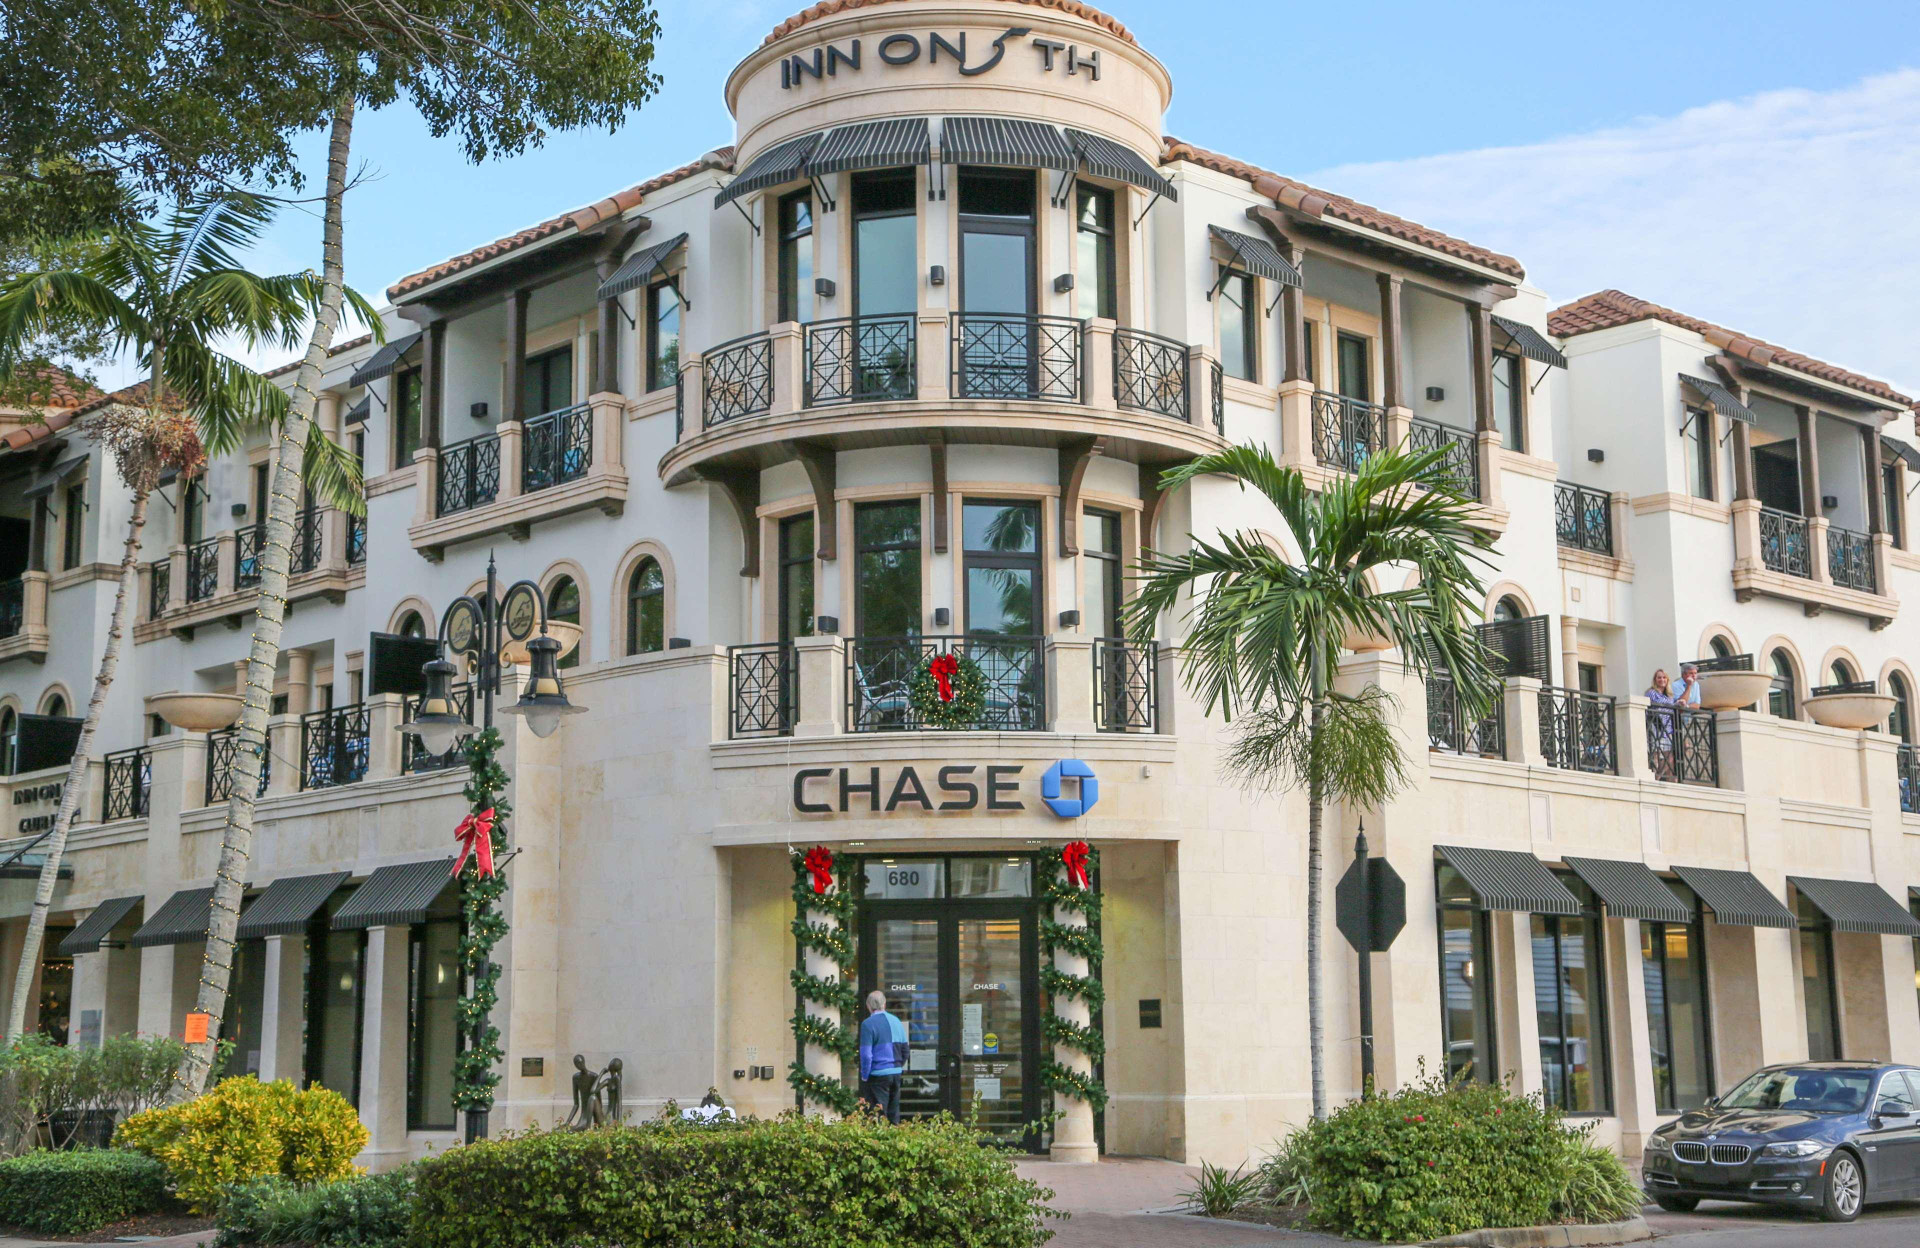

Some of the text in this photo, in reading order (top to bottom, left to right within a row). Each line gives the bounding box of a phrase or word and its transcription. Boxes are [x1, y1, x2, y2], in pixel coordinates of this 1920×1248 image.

[781, 39, 861, 89] INN
[878, 31, 967, 65] ON
[793, 765, 1025, 813] CHASE
[889, 871, 920, 886] 680
